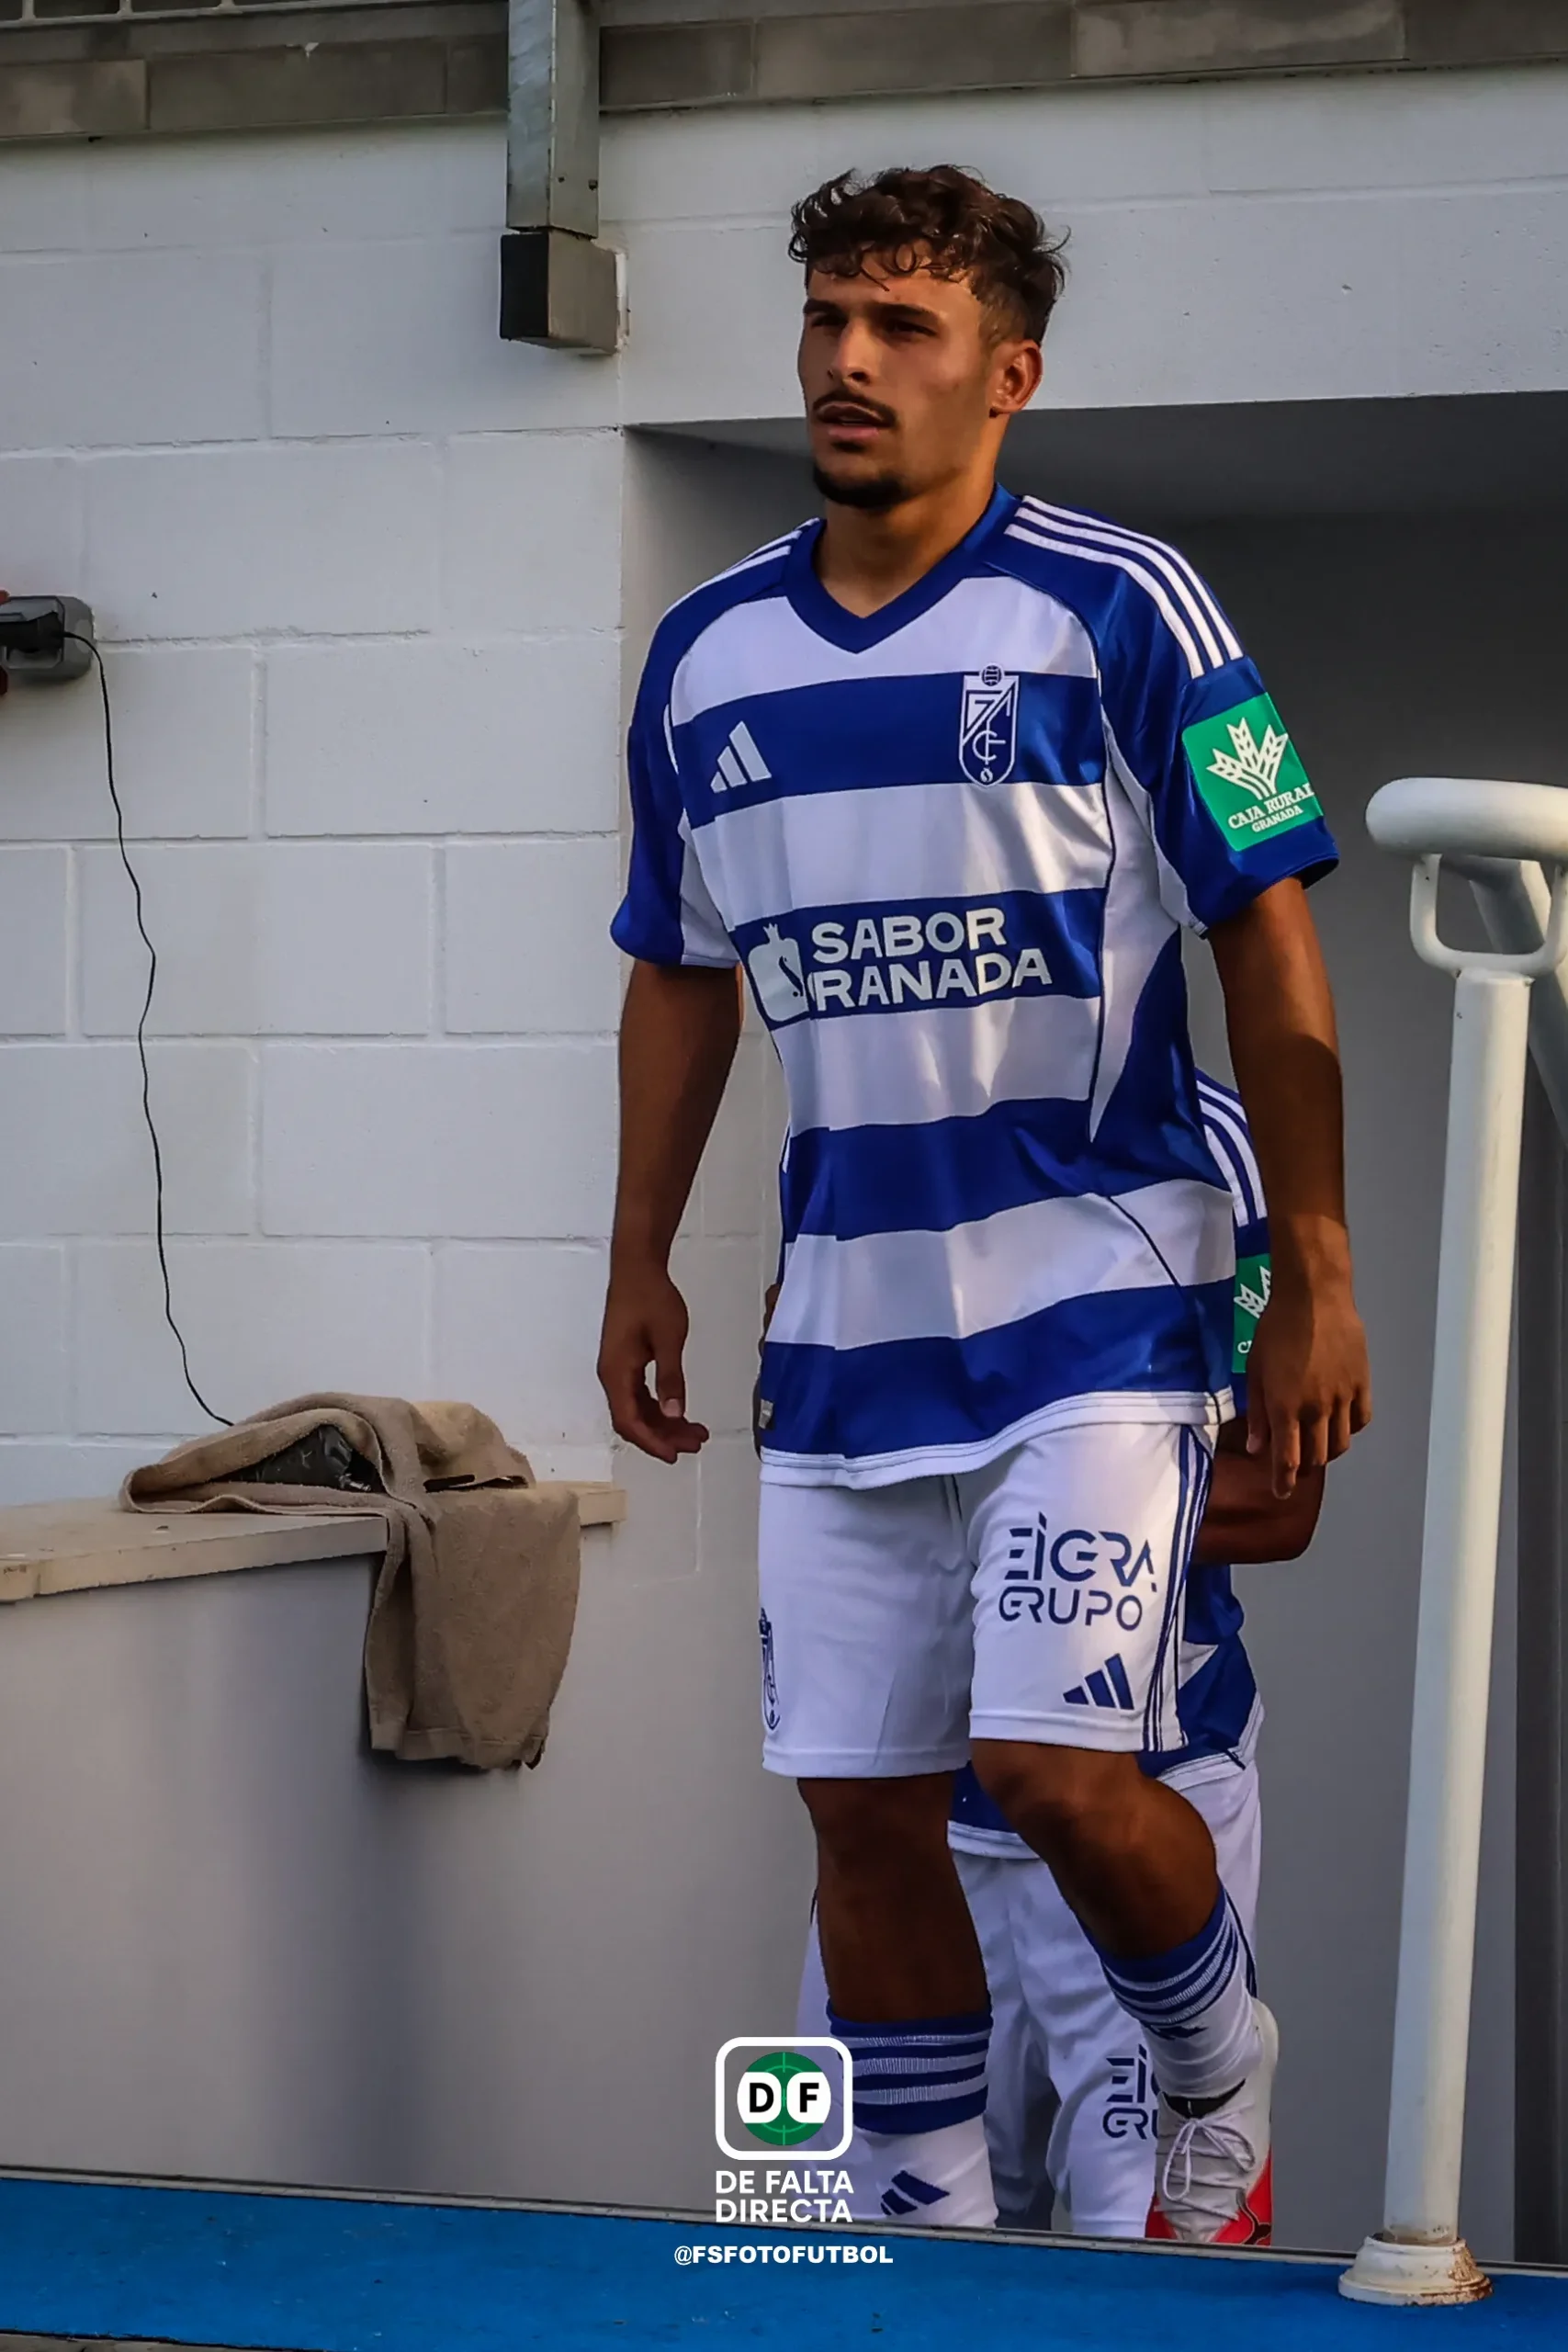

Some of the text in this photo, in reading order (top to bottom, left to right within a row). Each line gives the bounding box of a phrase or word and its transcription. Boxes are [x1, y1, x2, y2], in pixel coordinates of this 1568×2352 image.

[1228, 783, 1315, 830] CAJA RURAL
[1251, 805, 1303, 832] GRANADA
[811, 907, 1007, 964] SABOR
[807, 948, 1053, 1012] RANADA
[998, 1586, 1143, 1631] GRUPO
